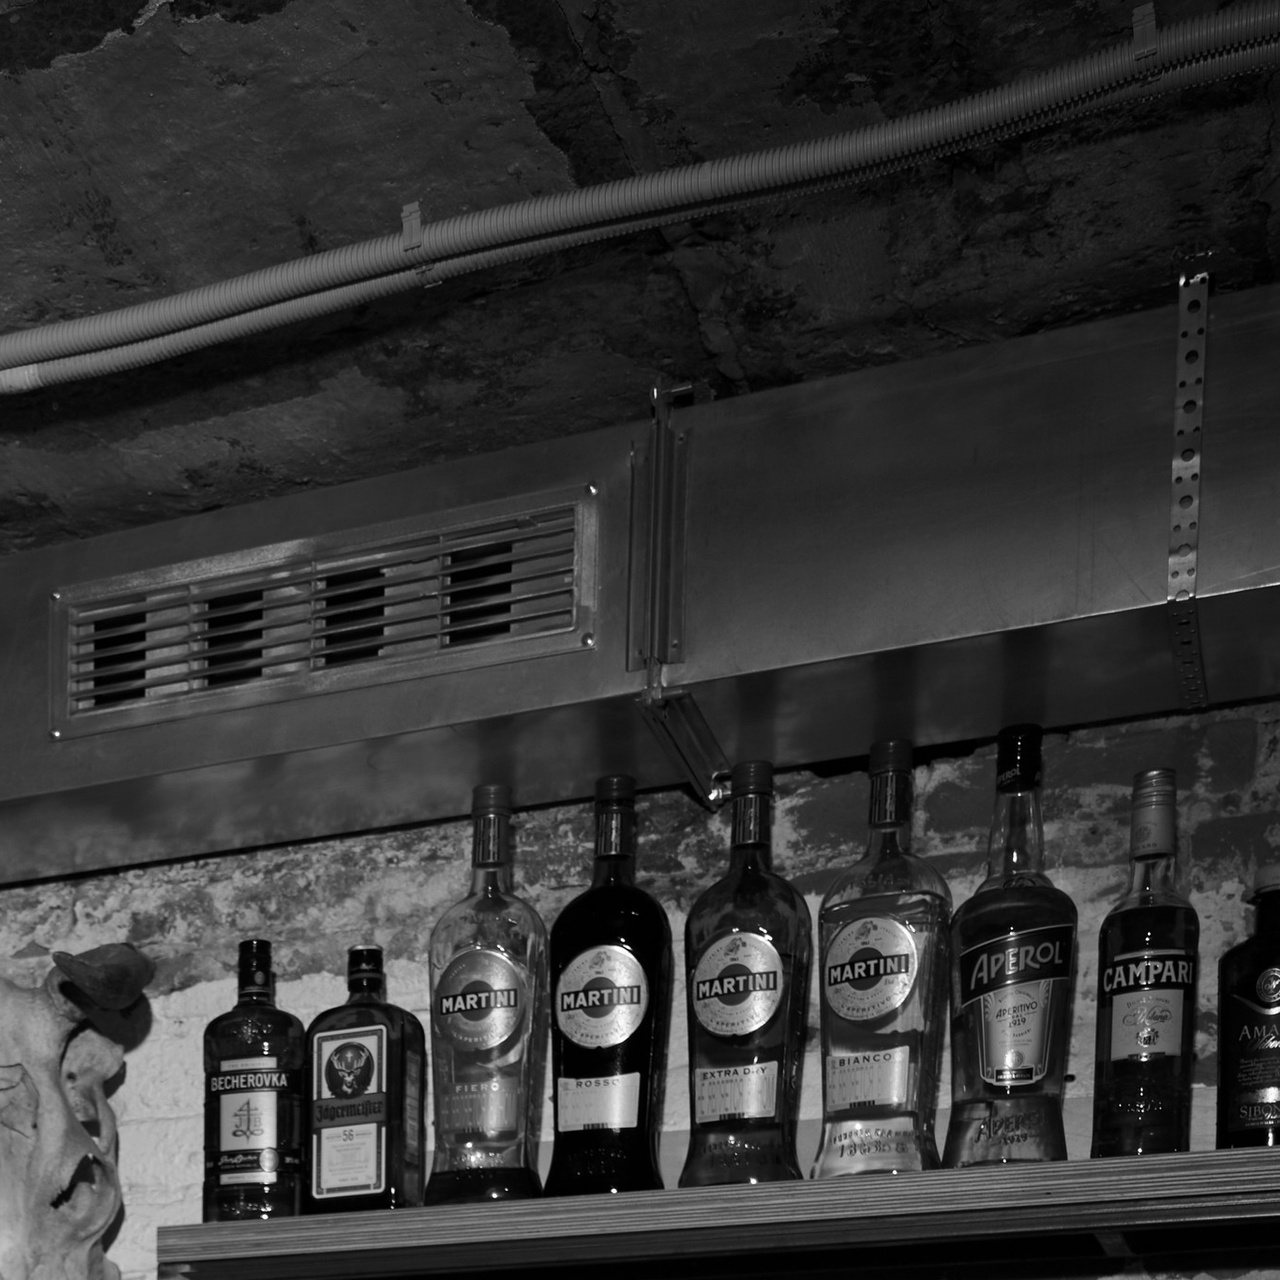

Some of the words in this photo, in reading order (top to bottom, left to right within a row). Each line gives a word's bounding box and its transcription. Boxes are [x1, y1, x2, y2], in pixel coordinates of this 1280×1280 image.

[829, 956, 907, 984] MARTINI
[970, 941, 1063, 991] APEROL
[1103, 960, 1194, 992] CAMPARI
[698, 972, 776, 999] MARTINI
[441, 989, 516, 1014] MARTINI
[562, 986, 639, 1011] MARTINI
[995, 1001, 1038, 1019] APERITIVO
[838, 1053, 892, 1068] BIANCO
[210, 1073, 288, 1092] BECHEROVKA
[576, 1078, 620, 1089] ROSSO
[703, 1067, 739, 1081] EXTRA
[743, 1066, 768, 1076] DY
[455, 1082, 500, 1094] FIERO
[316, 1101, 384, 1122] Jägermeister
